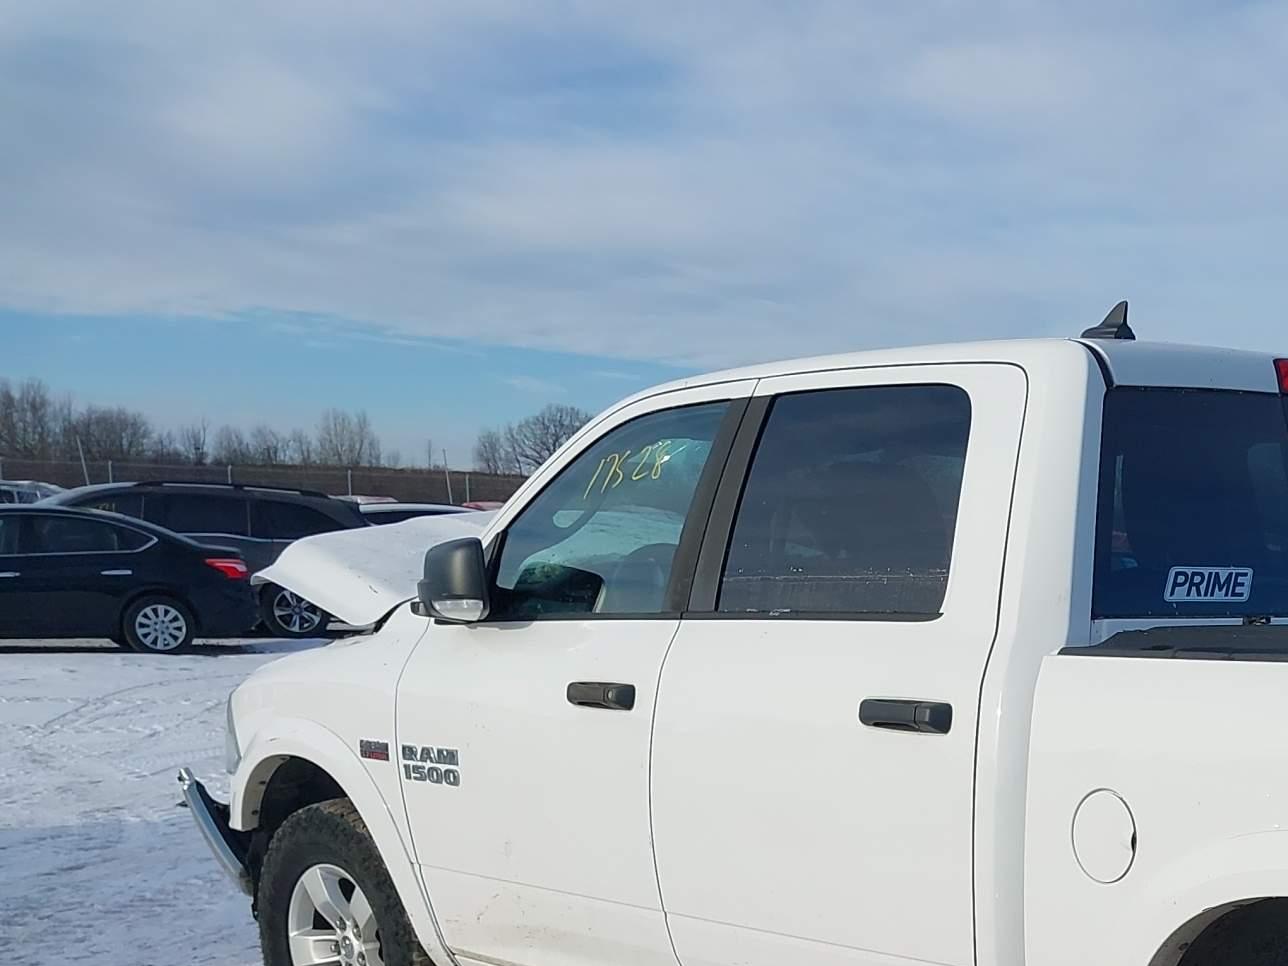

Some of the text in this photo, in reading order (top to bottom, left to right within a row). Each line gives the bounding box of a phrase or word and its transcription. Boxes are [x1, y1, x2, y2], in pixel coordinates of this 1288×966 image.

[1169, 570, 1249, 598] PRIME
[402, 744, 459, 766] RAM
[403, 763, 461, 787] 1500
